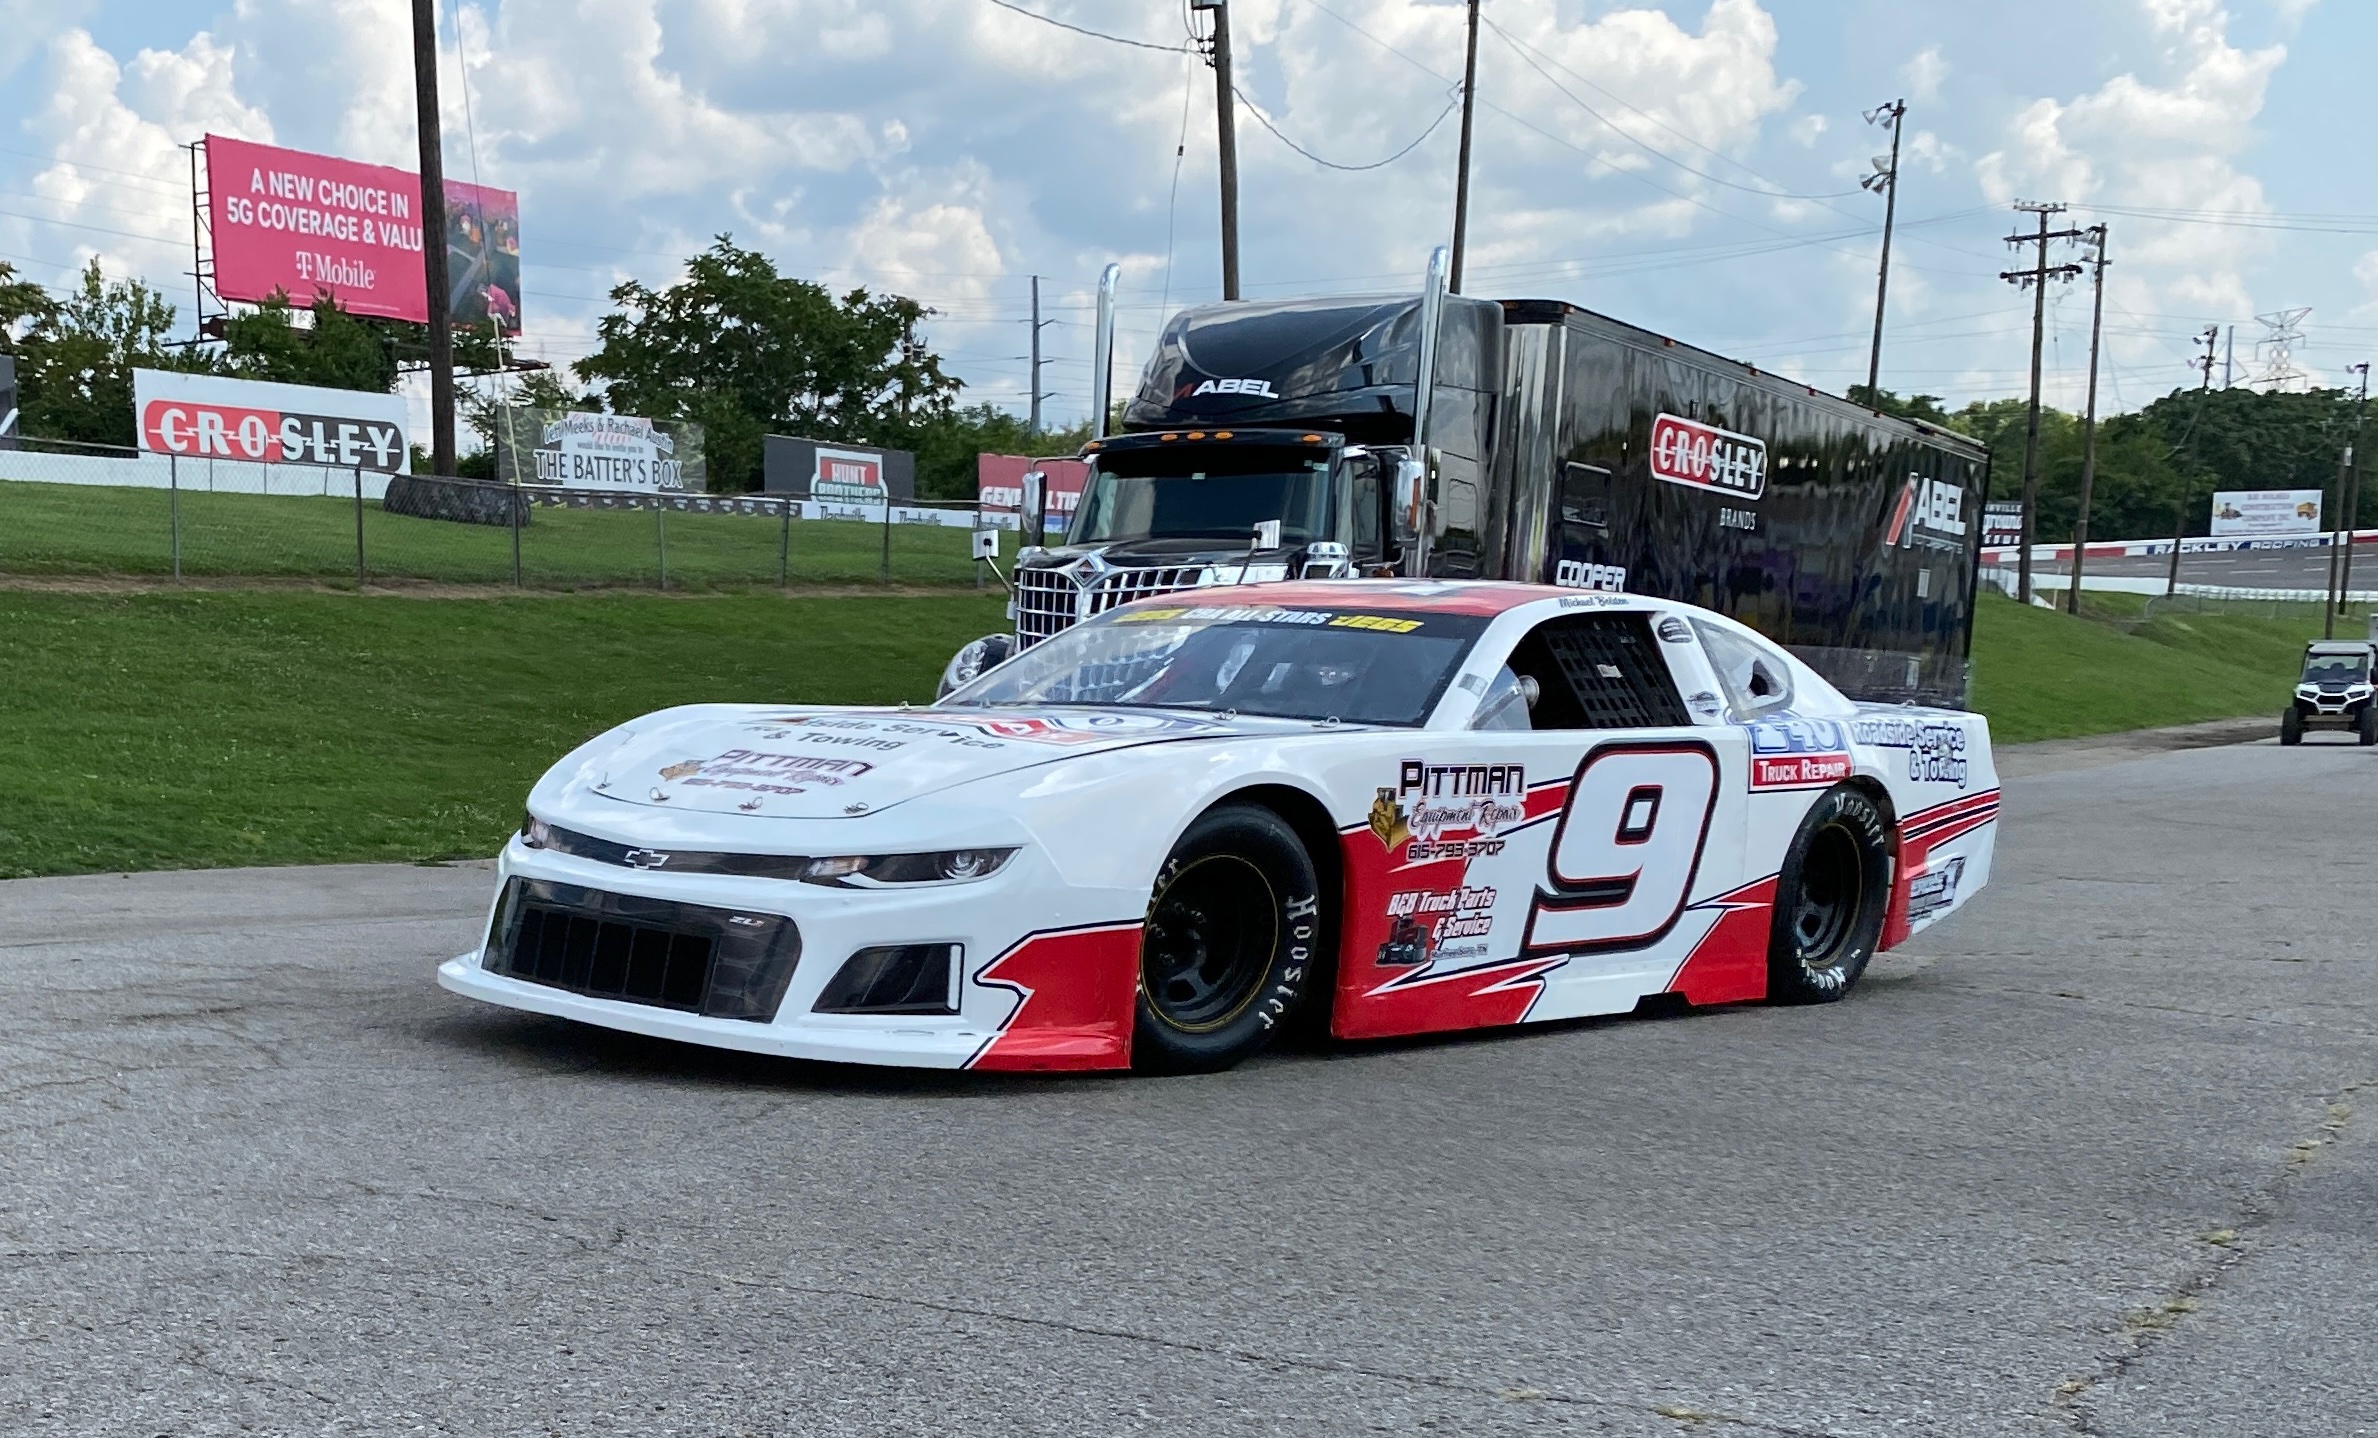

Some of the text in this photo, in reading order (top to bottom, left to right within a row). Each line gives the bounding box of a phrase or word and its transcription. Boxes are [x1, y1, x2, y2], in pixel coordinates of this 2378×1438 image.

[251, 168, 409, 219] A NEW CHOICE IN
[227, 197, 422, 252] 5G COVERAGE & VALU
[315, 253, 375, 289] Mobile
[1192, 379, 1279, 398] ABEL
[160, 408, 395, 467] CROSLEY
[564, 418, 594, 434] Meeks
[597, 417, 606, 431] &
[608, 417, 643, 438] Rachael
[535, 451, 682, 488] THE BATTER'S BOX
[1658, 426, 1763, 490] CROSLEY
[831, 463, 867, 485] HUNT
[1720, 508, 1756, 530] BRANDS
[1914, 478, 1966, 535] ABEL
[2154, 541, 2248, 555] RACKLEY
[1556, 560, 1626, 592] COOPER
[796, 731, 909, 751] Towing
[1852, 720, 1916, 748] Roadside
[1910, 751, 1922, 782] &
[1411, 799, 1522, 833] Equipment Repair
[1408, 840, 1506, 859] 615-793-3707
[1519, 737, 1721, 959] 9
[1419, 889, 1458, 912] Truck
[1458, 887, 1497, 910] Parts
[1443, 914, 1492, 938] Service
